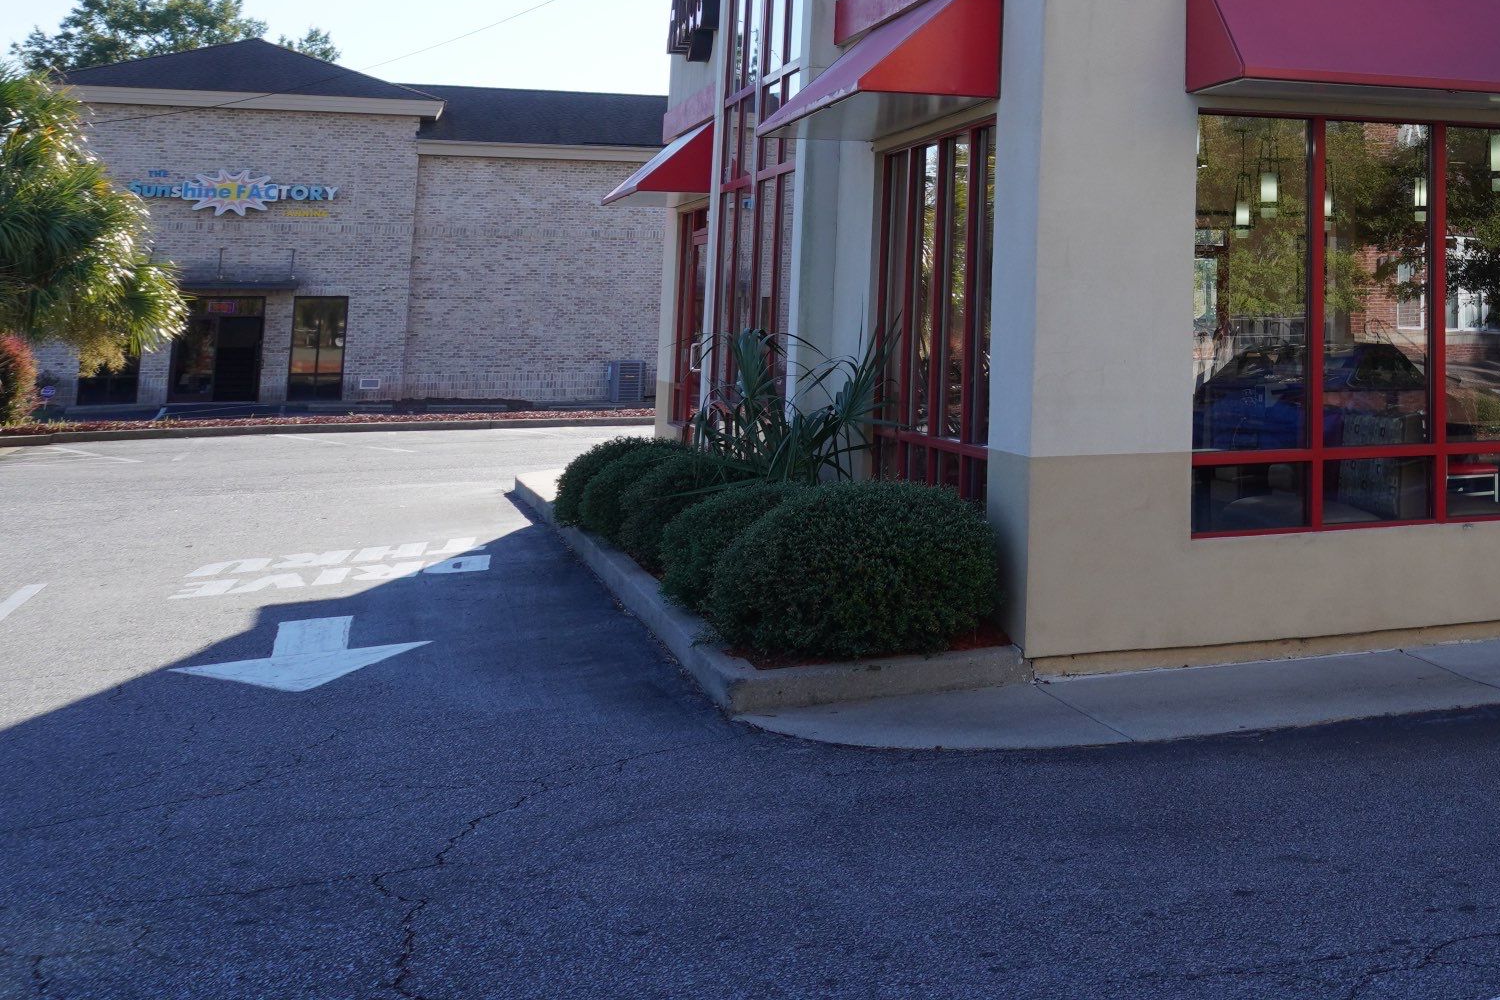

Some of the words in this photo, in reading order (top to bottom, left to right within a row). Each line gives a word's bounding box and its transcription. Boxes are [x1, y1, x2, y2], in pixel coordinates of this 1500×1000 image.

[148, 169, 169, 178] THE
[127, 180, 231, 200] Sunshine
[237, 183, 339, 201] FACTORY
[183, 536, 487, 578] THRU
[167, 554, 491, 600] DRIVE
